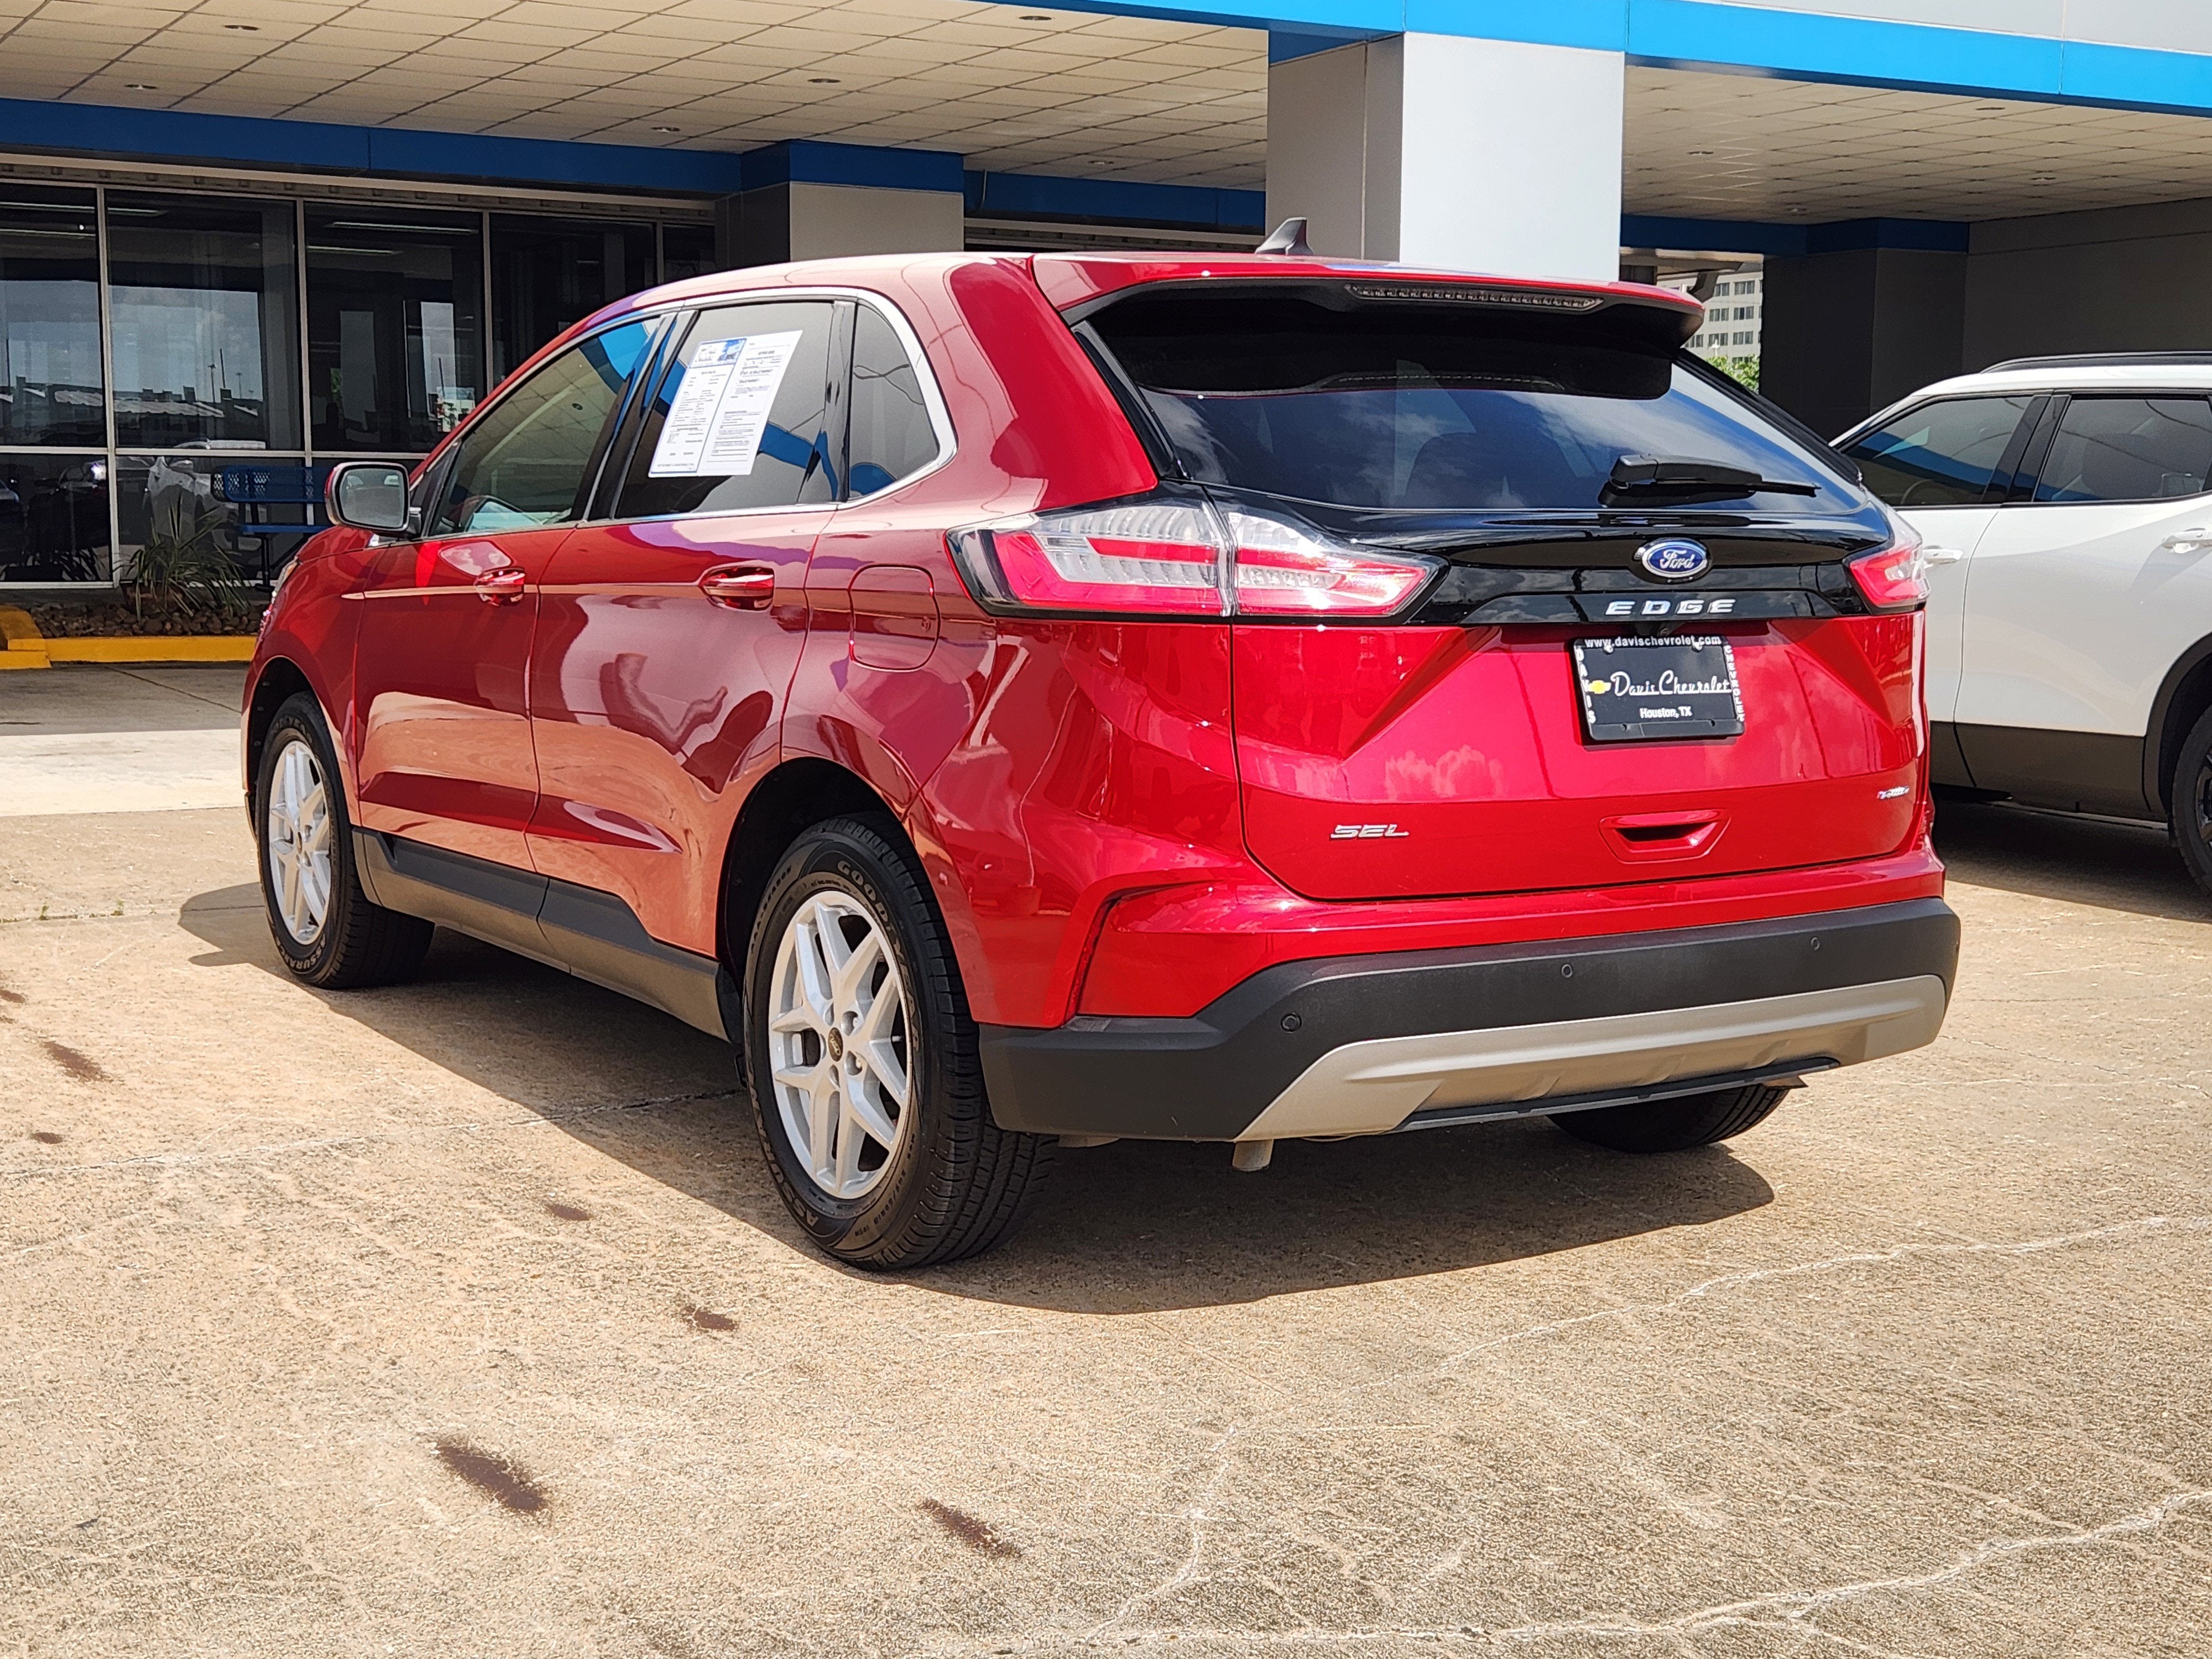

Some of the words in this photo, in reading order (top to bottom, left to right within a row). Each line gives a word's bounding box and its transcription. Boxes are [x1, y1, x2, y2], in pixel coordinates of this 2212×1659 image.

[1660, 549, 1695, 569] Ford
[1605, 599, 1736, 615] EDGE
[1584, 635, 1722, 648] www.davischevrolet.com
[1576, 648, 1597, 724] DAVIS
[1610, 671, 1660, 697] Davis
[1659, 670, 1733, 695] Chevrolet
[1723, 645, 1745, 722] CHEVROLET
[1640, 707, 1679, 719] Houston,
[1678, 706, 1693, 717] TX
[1330, 824, 1410, 839] SEL
